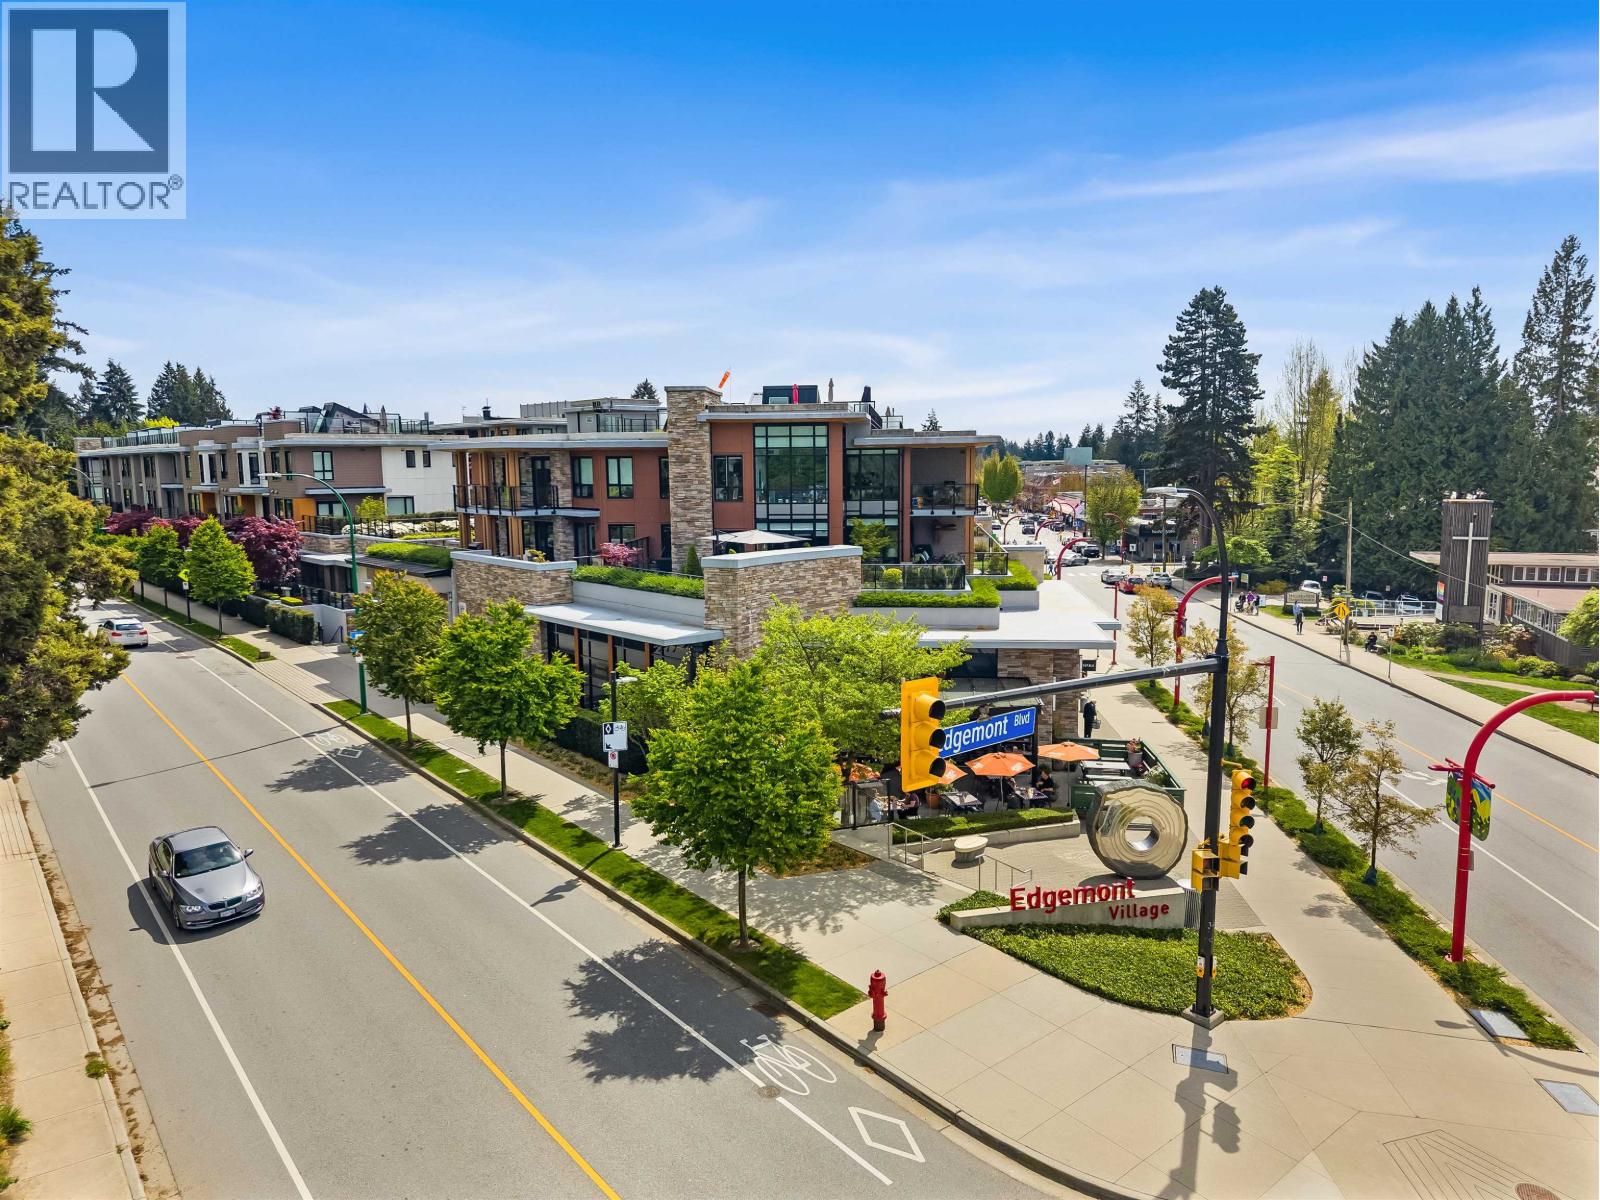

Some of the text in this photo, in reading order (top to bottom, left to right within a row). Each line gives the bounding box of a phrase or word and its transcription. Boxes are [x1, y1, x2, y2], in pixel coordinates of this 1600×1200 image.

[939, 711, 1030, 753] dgemont Blvd
[1009, 876, 1136, 914] Edgemont
[1109, 903, 1170, 920] Village
